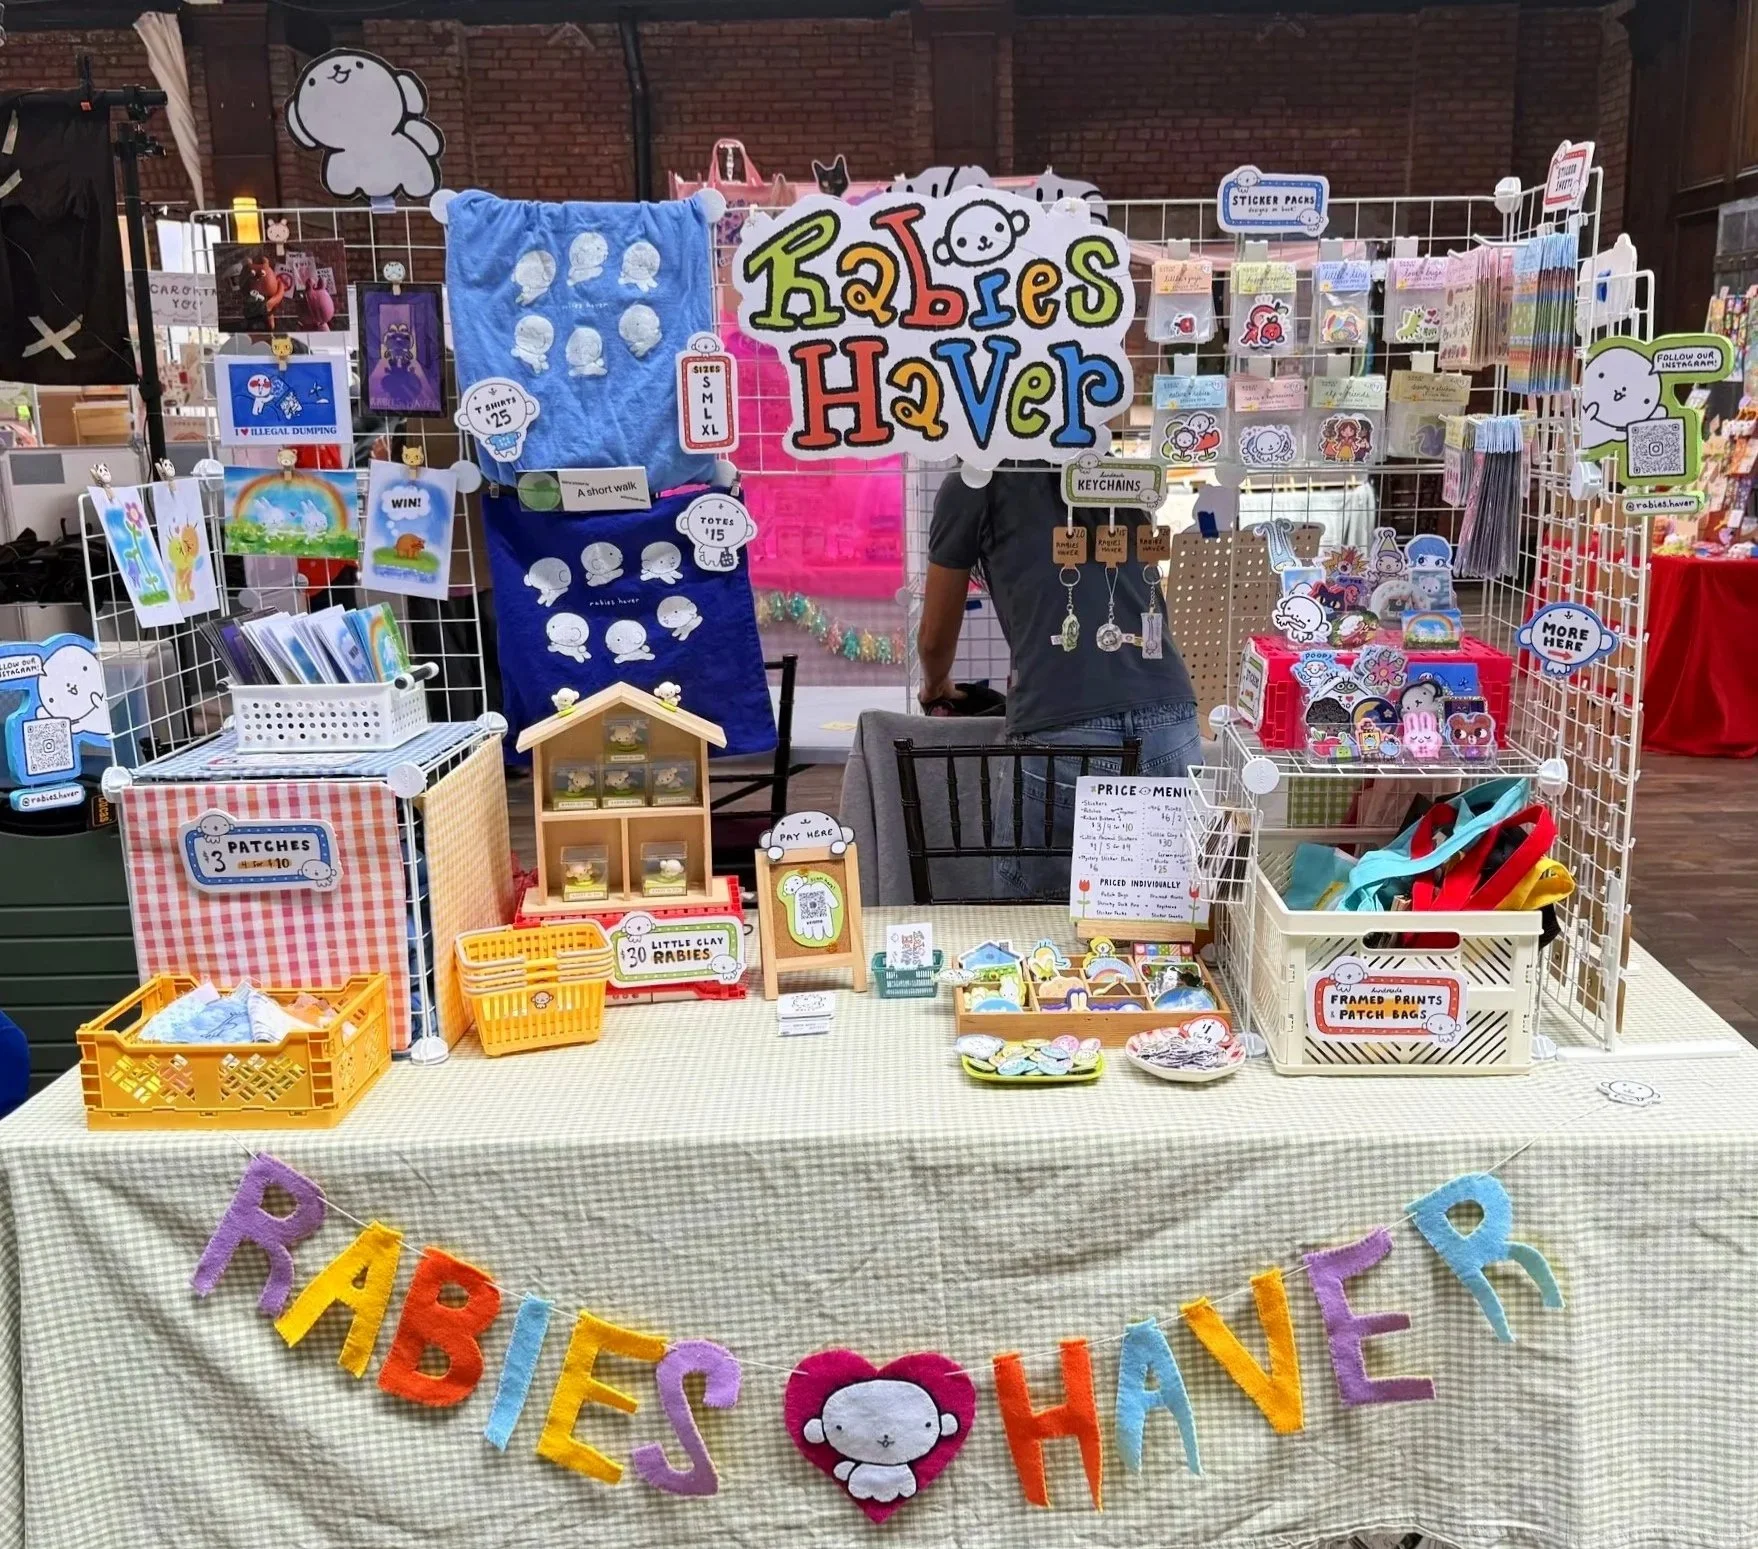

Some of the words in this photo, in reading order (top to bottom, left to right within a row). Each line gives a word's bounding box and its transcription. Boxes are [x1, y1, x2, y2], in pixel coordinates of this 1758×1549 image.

[1232, 195, 1279, 206] STICKER
[1285, 195, 1315, 205] PACKS
[744, 203, 1124, 331] Rabies
[1657, 353, 1694, 363] FOLLOW
[1697, 350, 1715, 360] OUR
[693, 365, 721, 374] SIZES
[1661, 360, 1717, 369] INSTAGRAM!
[703, 376, 711, 388] S
[702, 393, 713, 404] M
[475, 406, 482, 415] T
[485, 396, 517, 412] SHIRTS
[704, 408, 712, 419] L
[234, 428, 240, 437] I
[251, 427, 290, 439] ILLEGAL
[292, 425, 337, 438] DUMPING
[701, 424, 719, 436] XL
[577, 488, 586, 498] A
[587, 484, 613, 497] short
[613, 481, 638, 493] walk
[1077, 479, 1142, 492] KEYCHAINS
[391, 498, 422, 509] WIN!
[1625, 499, 1696, 512] @rabies.haver
[700, 517, 735, 526] TOTES
[1542, 621, 1590, 641] MORE
[1543, 637, 1584, 652] HERE
[22, 657, 36, 666] OUR
[1097, 783, 1138, 796] PRICE
[779, 833, 801, 842] PAY
[806, 828, 834, 839] HERE
[227, 839, 311, 854] PATCHES
[1099, 878, 1127, 887] PRICED
[1131, 879, 1182, 889] INDIVIDUALLY
[651, 939, 691, 950] LITTLE
[697, 936, 725, 947] CLAY
[653, 948, 711, 965] RABIES
[1330, 994, 1385, 1005] FRAMED
[1394, 994, 1443, 1006] PRINTS
[1339, 1009, 1385, 1020] PATCH
[1392, 1009, 1428, 1020] BAGS
[190, 1151, 742, 1497] RABIES
[992, 1172, 1566, 1512] HAVER
